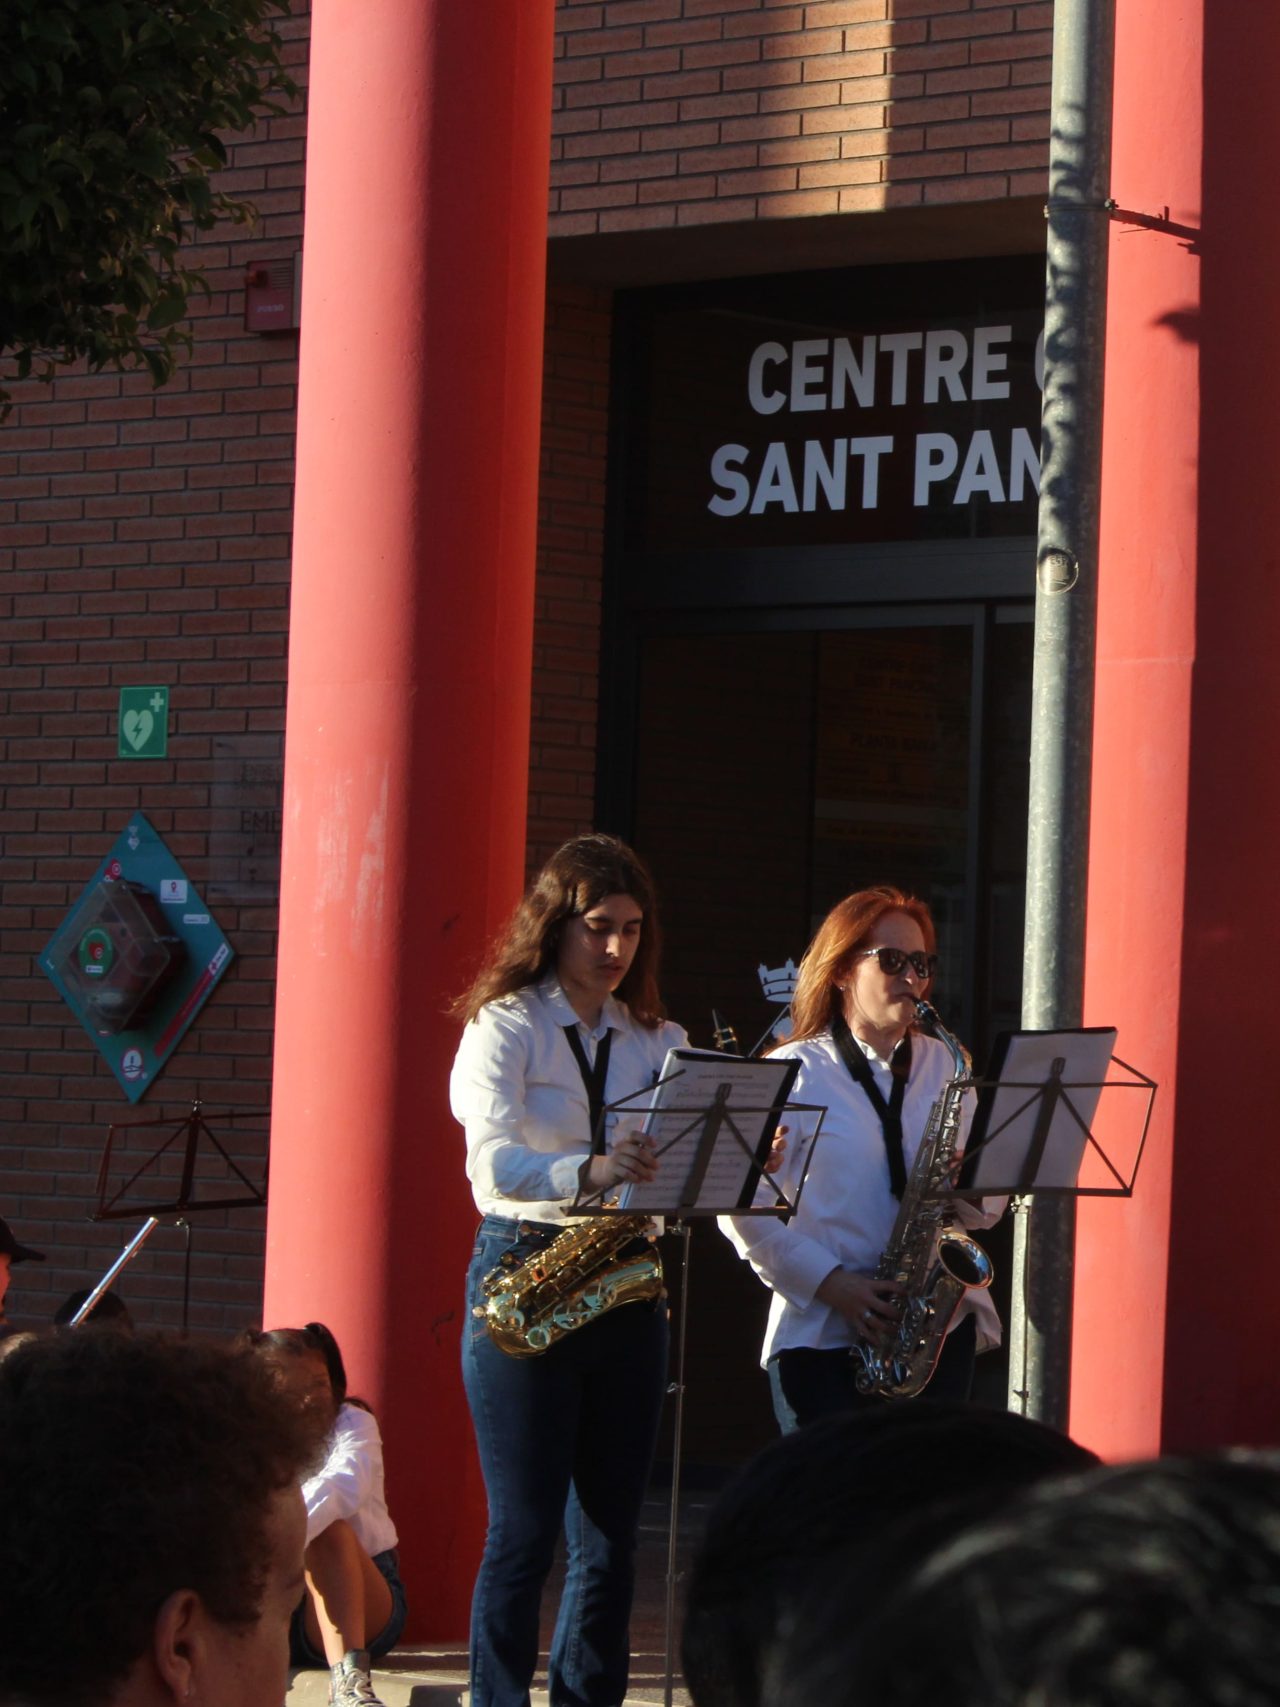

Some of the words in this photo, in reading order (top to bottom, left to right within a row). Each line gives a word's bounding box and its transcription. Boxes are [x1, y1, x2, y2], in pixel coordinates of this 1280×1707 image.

[748, 325, 1012, 415] CENTRE
[707, 435, 894, 517] SANT
[913, 427, 1042, 507] PAN
